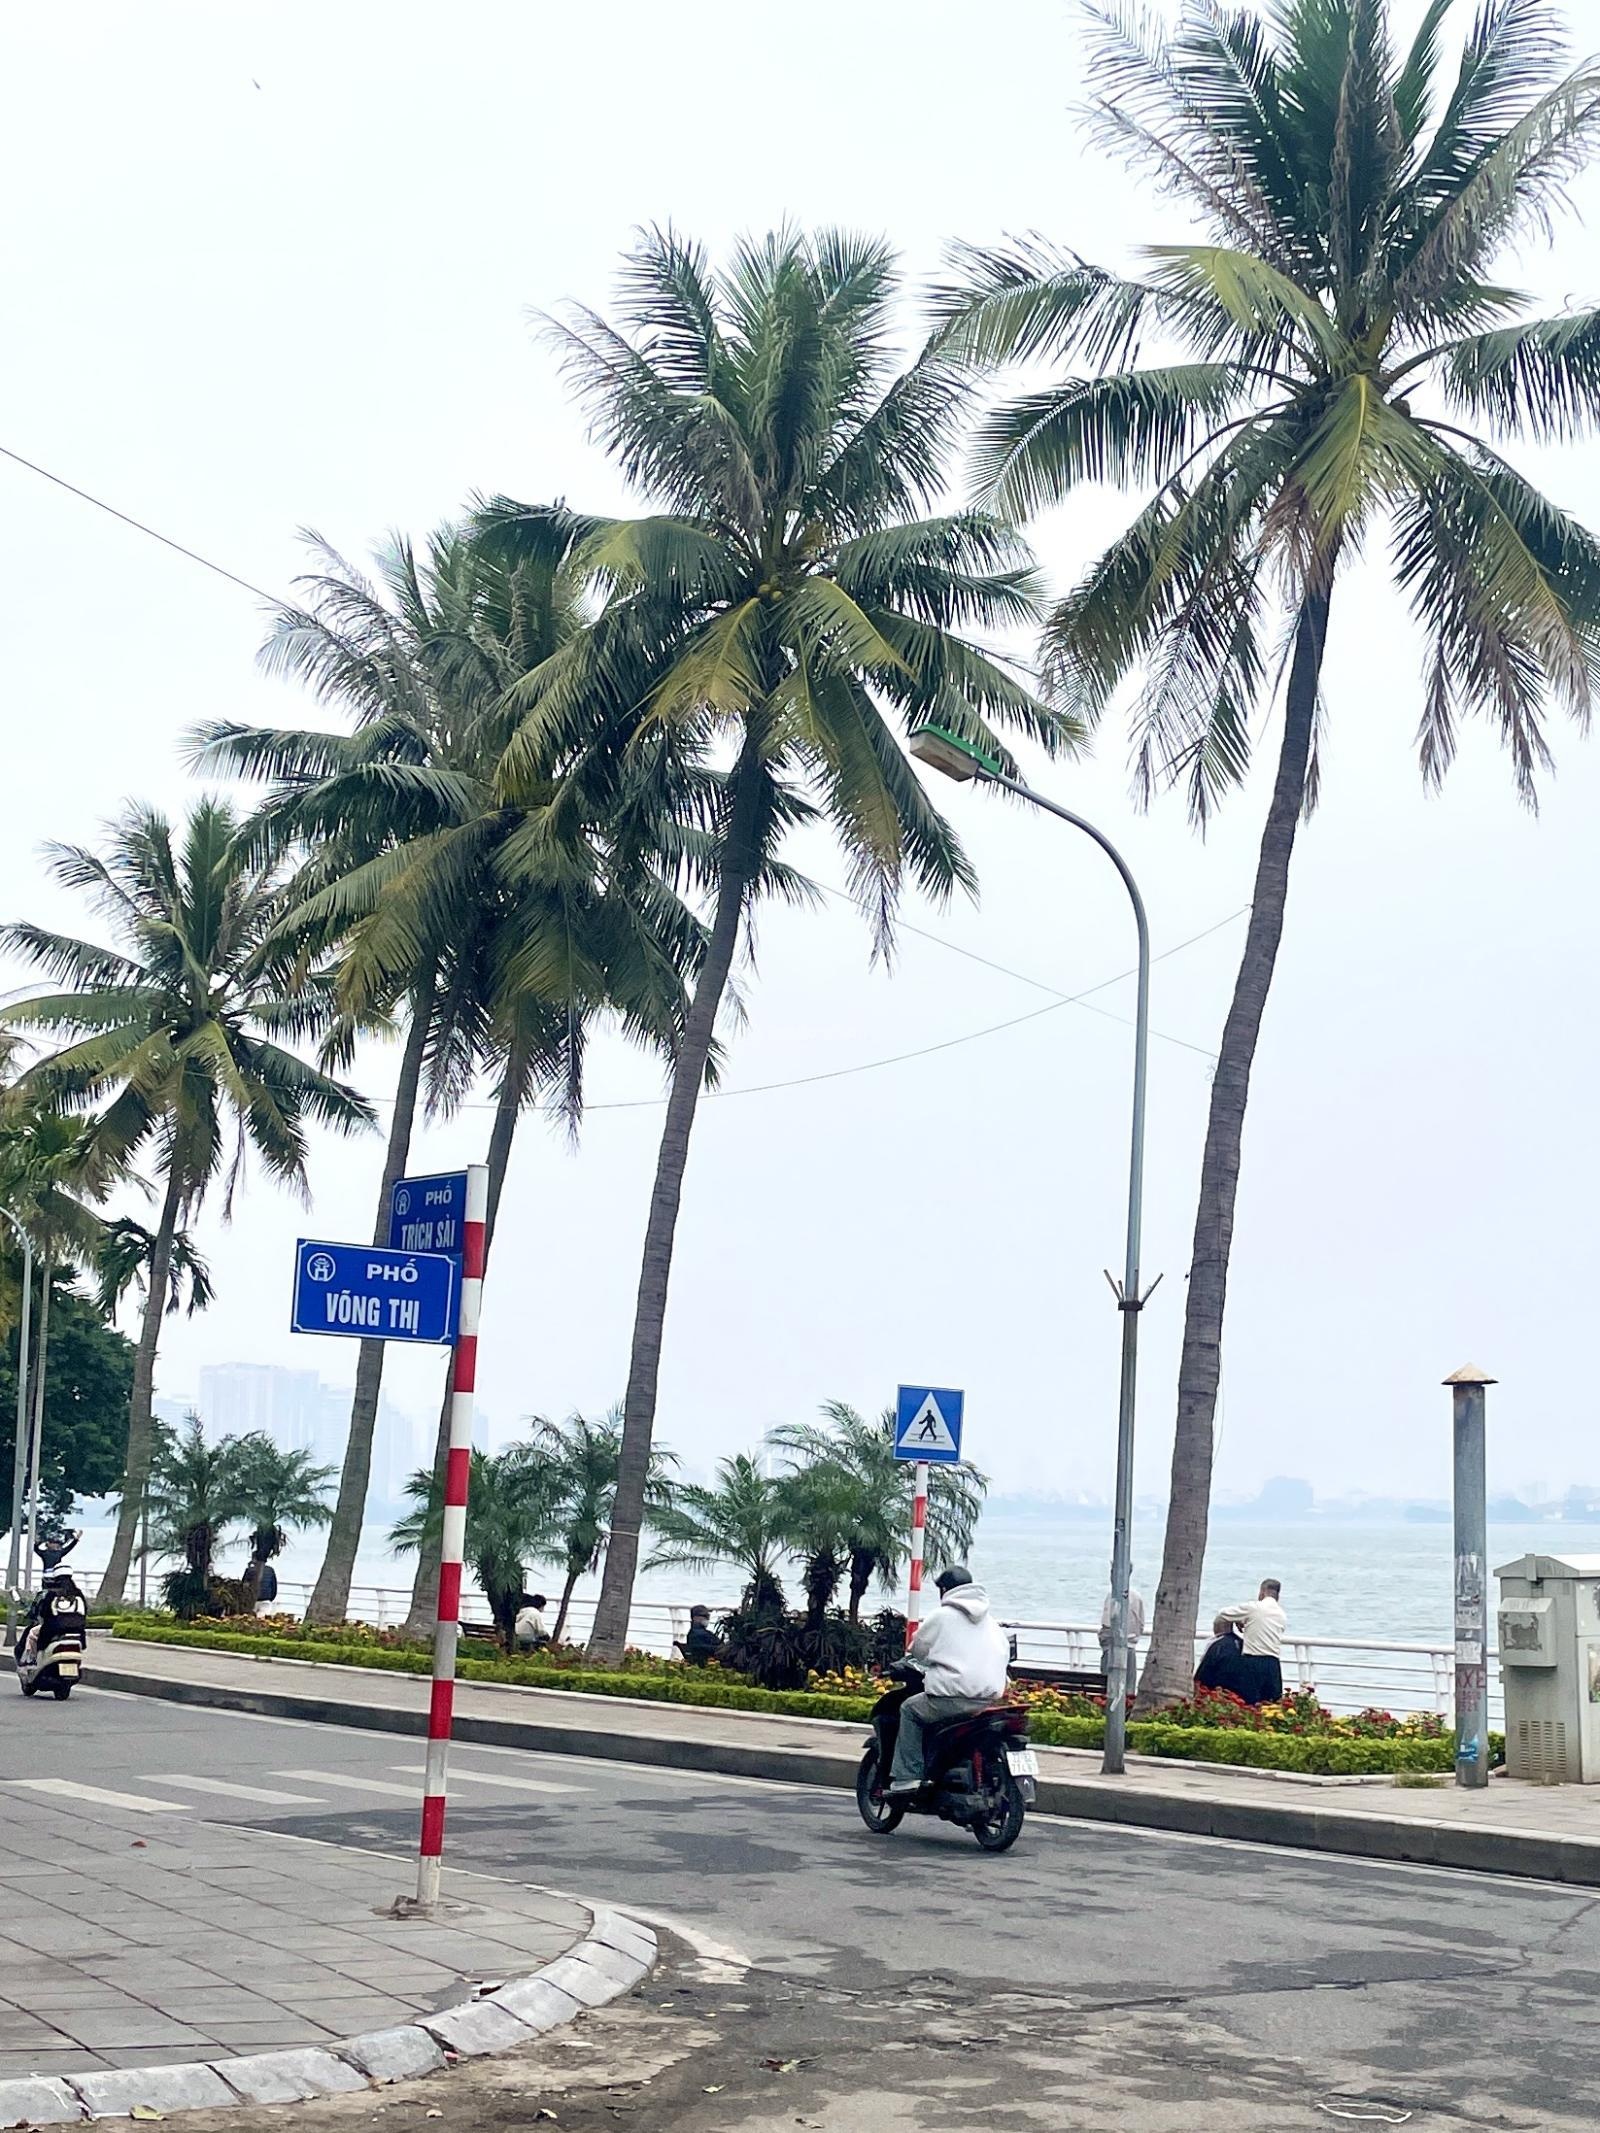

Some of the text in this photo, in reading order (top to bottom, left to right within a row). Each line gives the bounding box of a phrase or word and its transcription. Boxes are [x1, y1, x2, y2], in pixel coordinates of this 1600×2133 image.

[425, 1180, 453, 1206] PHỐ
[401, 1214, 456, 1250] TRÍCH SÀI
[366, 1258, 418, 1283] PHỐ
[326, 1290, 420, 1335] VÕNG THỊ
